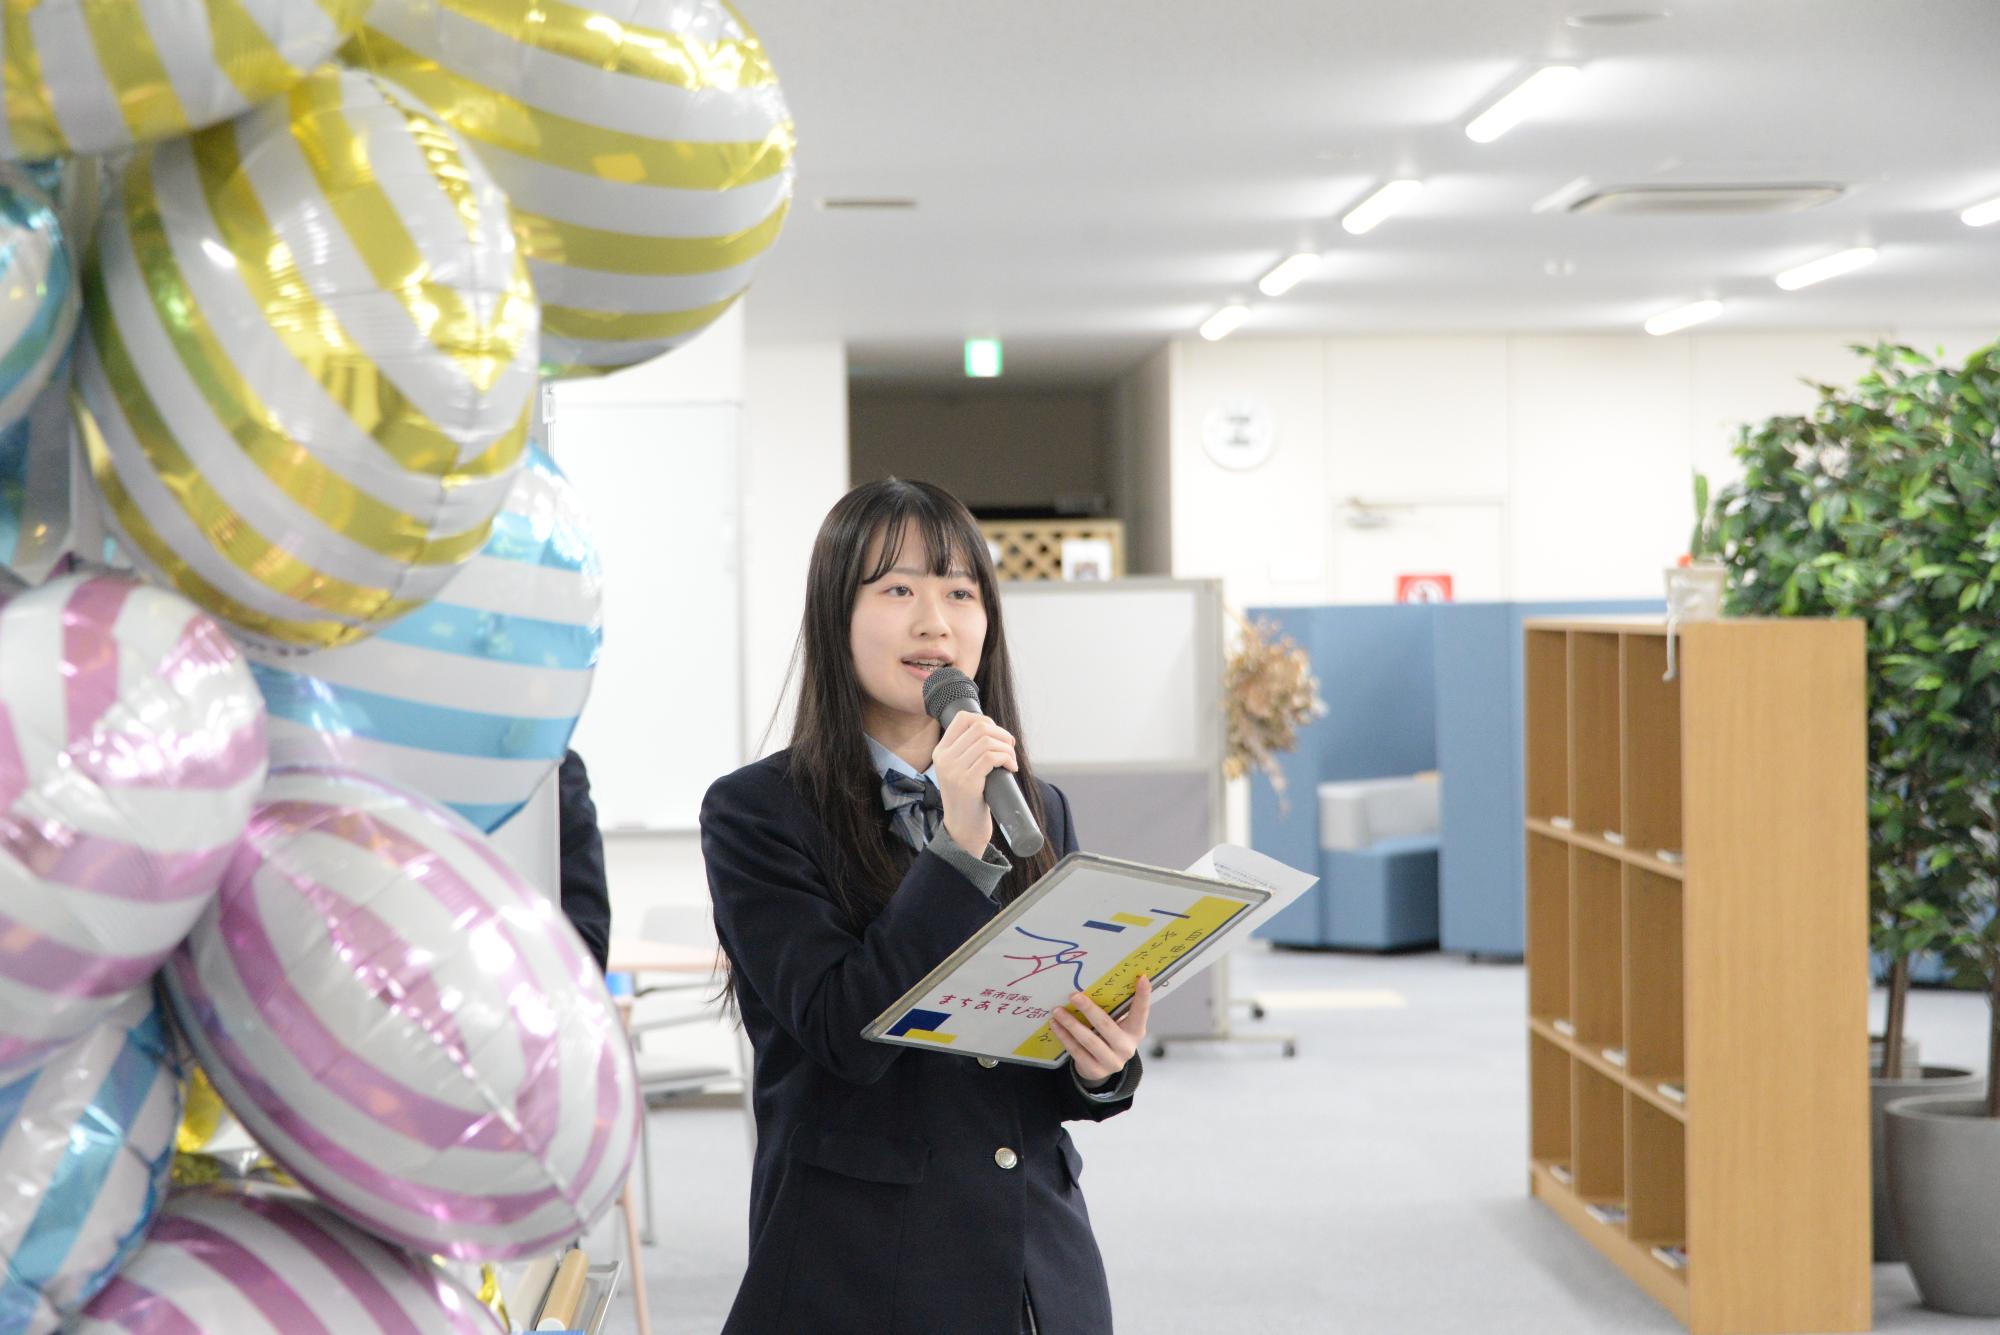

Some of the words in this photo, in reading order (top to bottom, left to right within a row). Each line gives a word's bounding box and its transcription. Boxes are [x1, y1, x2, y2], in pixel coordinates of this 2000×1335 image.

[938, 994, 1050, 1019] まちあそび部
